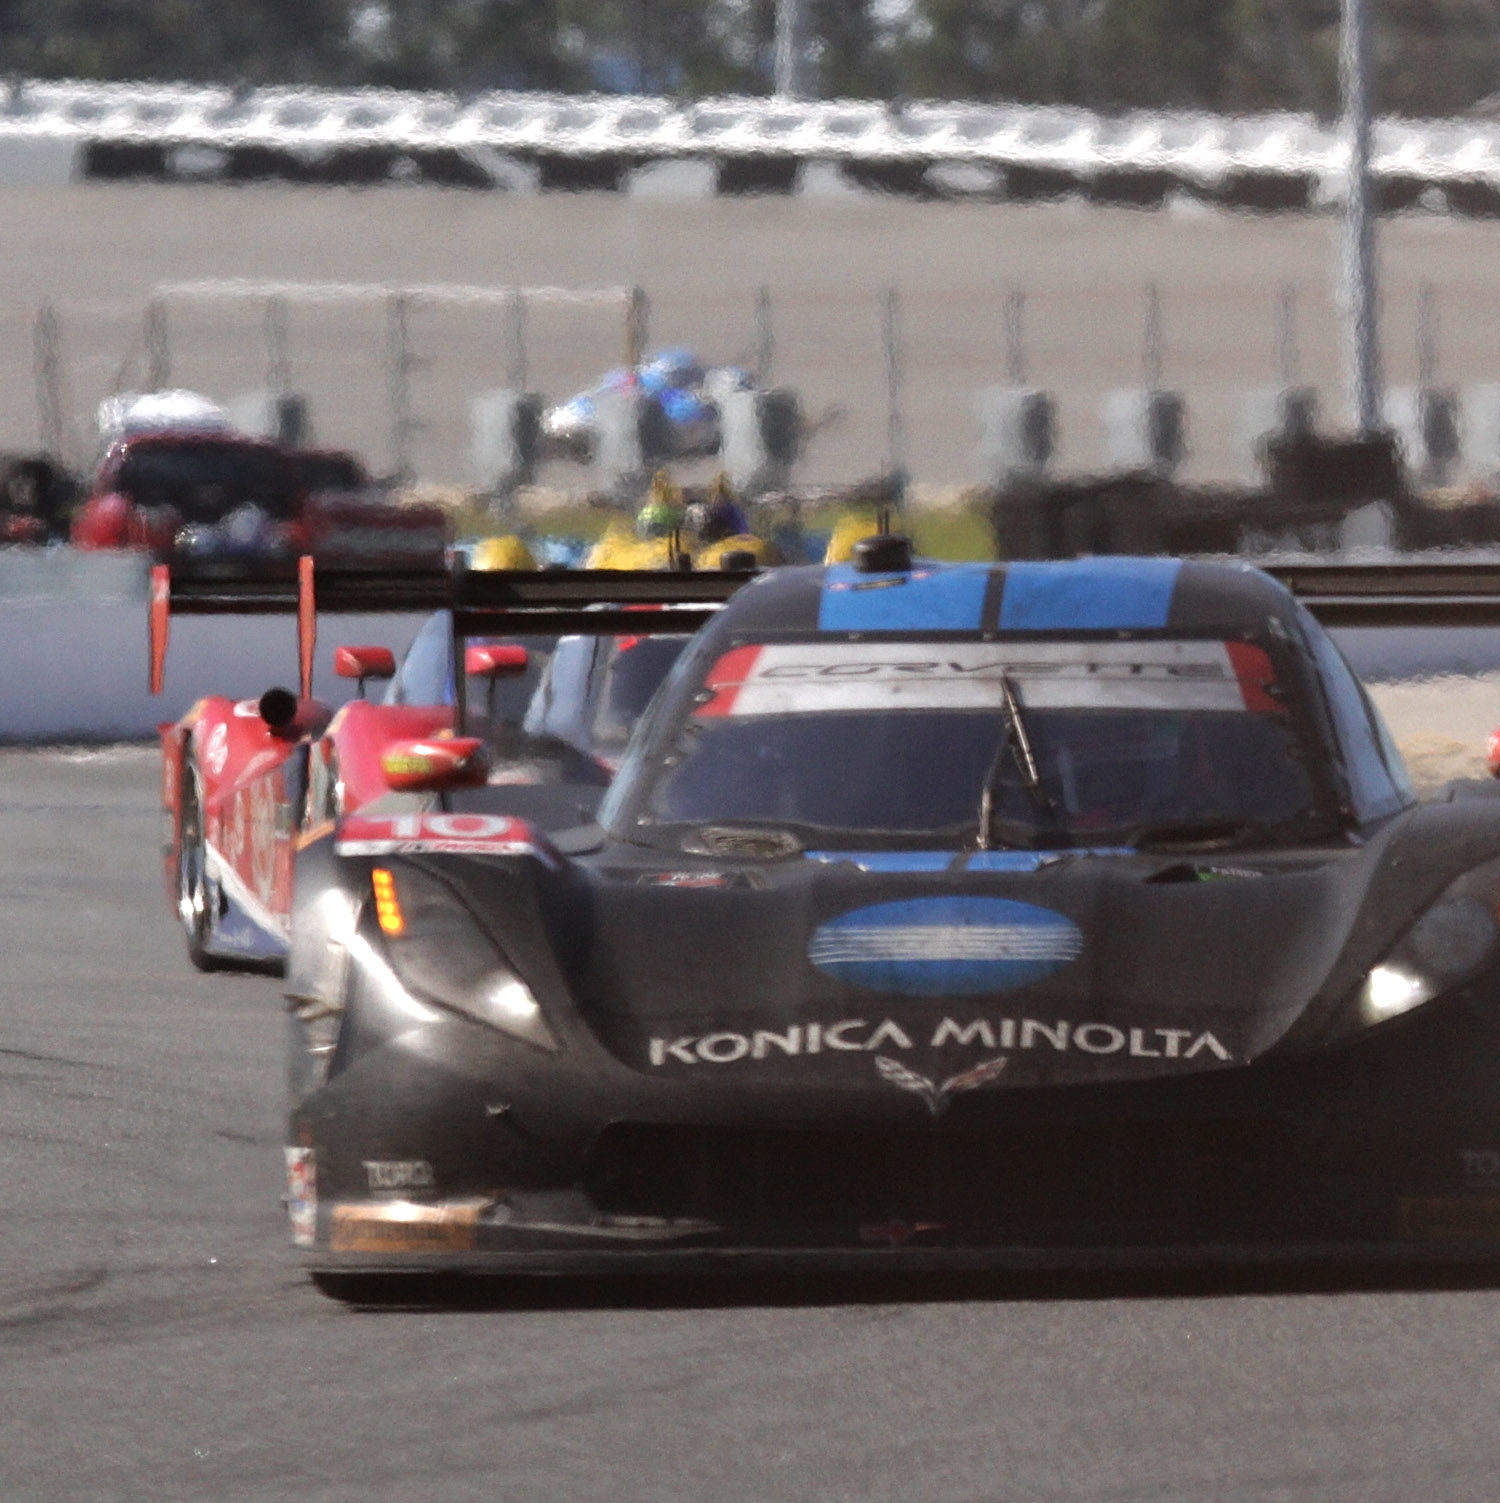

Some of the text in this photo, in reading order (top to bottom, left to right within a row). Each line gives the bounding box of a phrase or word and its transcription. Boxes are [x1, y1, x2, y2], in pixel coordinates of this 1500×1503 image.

[760, 661, 1224, 679] CORVETTE
[366, 815, 511, 838] 10
[649, 1018, 1233, 1066] KONICA MINOLTA
